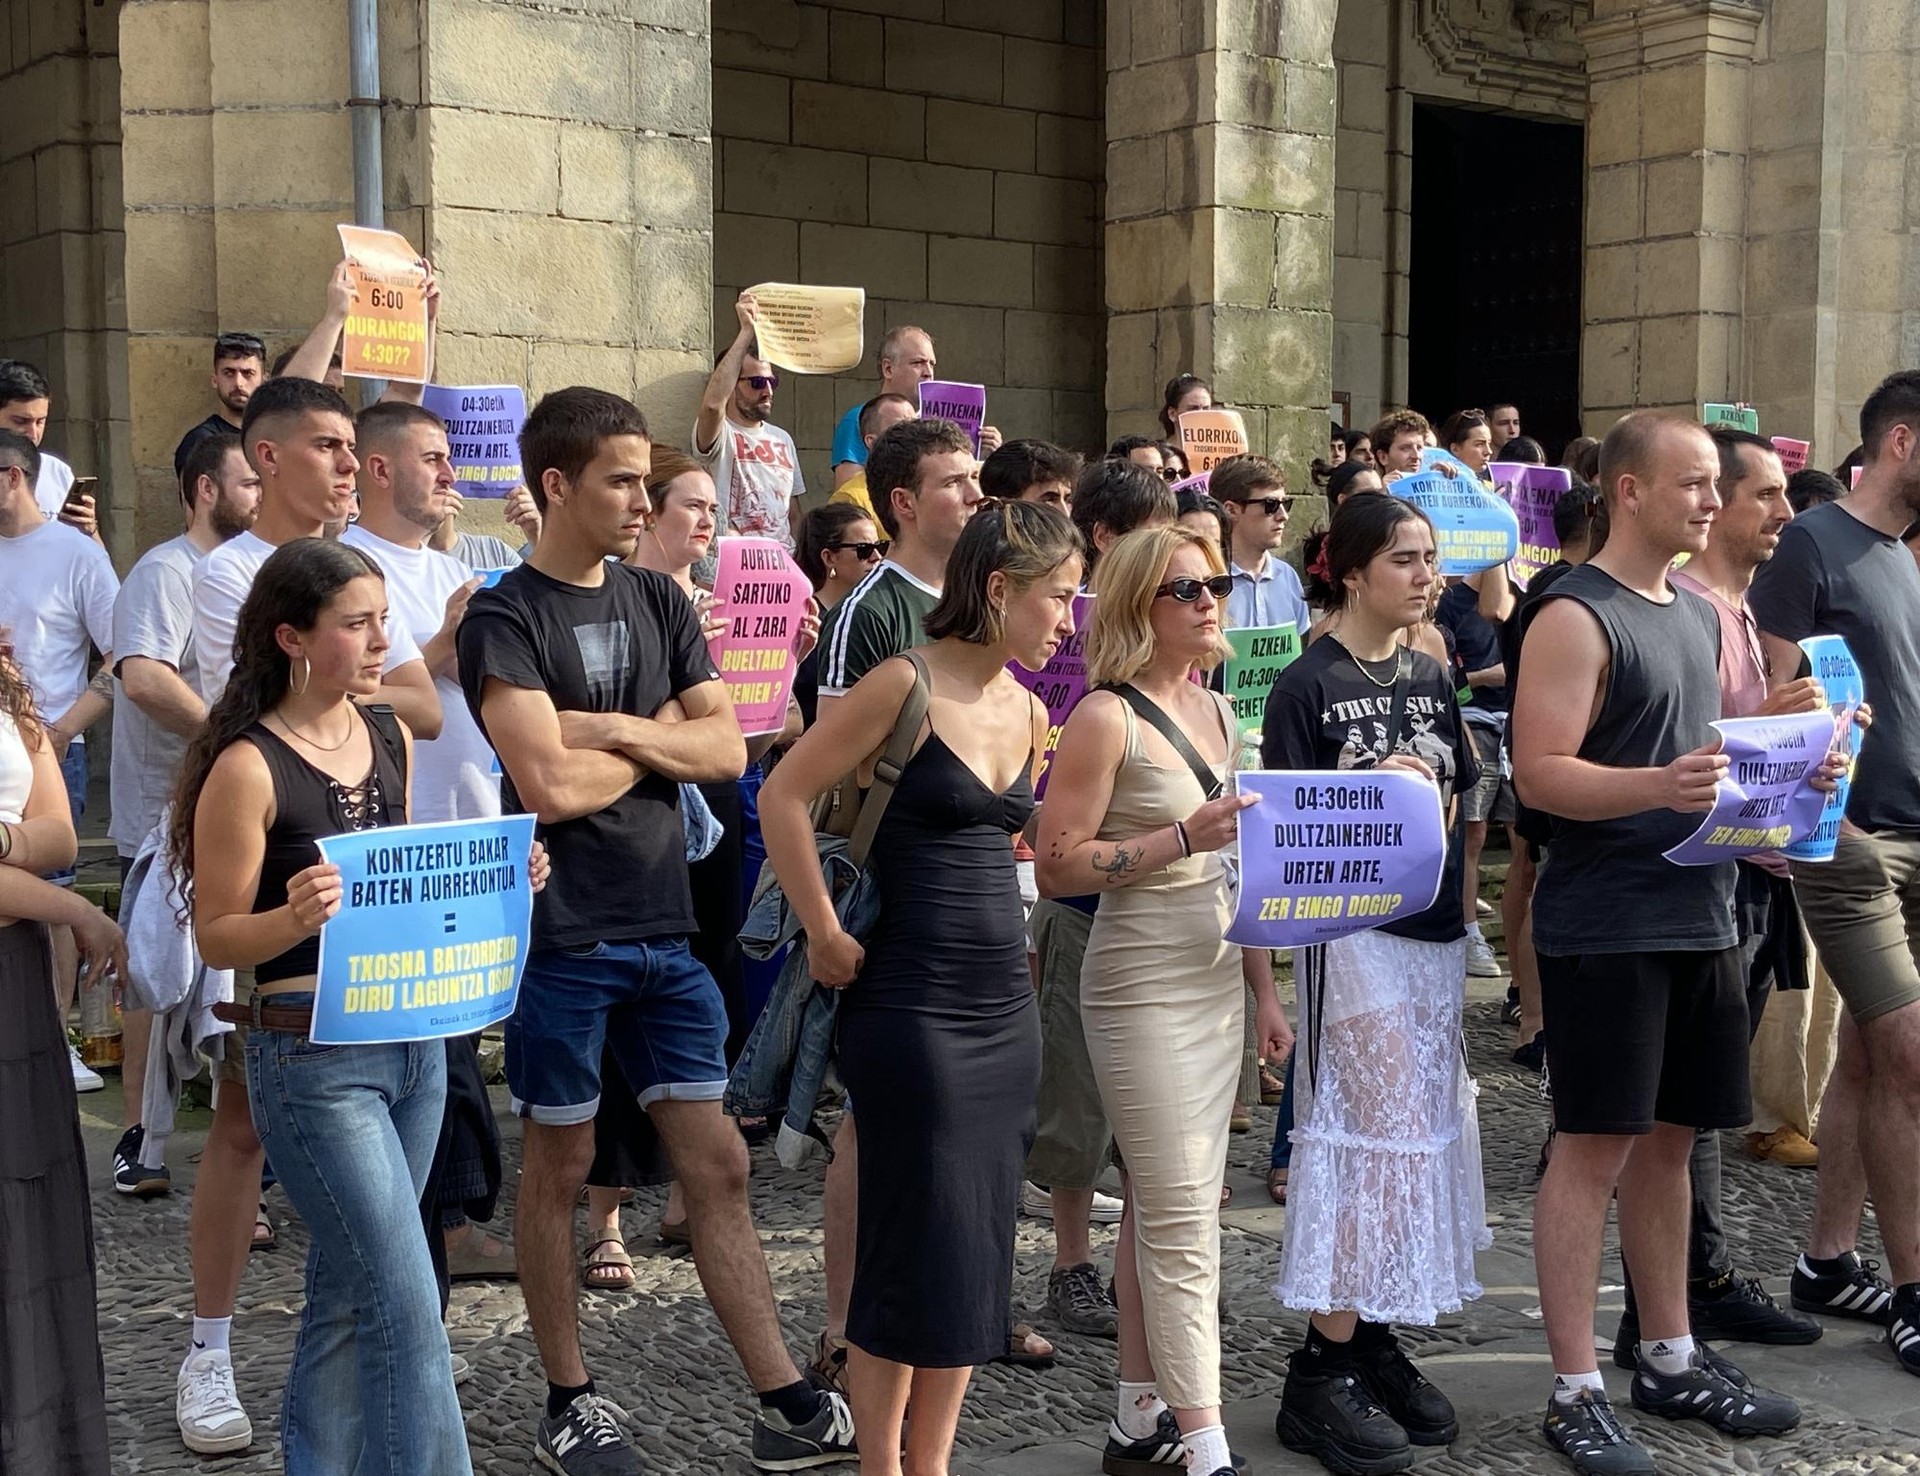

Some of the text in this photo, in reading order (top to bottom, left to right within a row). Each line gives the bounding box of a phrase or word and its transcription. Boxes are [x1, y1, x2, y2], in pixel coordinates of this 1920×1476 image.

[371, 288, 403, 310] 6:00
[345, 315, 425, 342] DURANGON
[362, 342, 410, 366] 4:30??
[461, 395, 505, 412] 04:30etik
[485, 443, 512, 459] ARTE,
[1411, 479, 1464, 494] KONTZERTU
[740, 548, 790, 573] AURTEN,
[732, 582, 791, 605] SARTUKO
[732, 616, 788, 638] AL ZARA
[1250, 634, 1293, 658] AZKENA
[721, 648, 789, 672] BUELTAKO
[1331, 697, 1376, 722] THE
[1294, 785, 1385, 811] 04:30etik
[1274, 822, 1403, 848] DULTZAINERUEK
[365, 835, 509, 876] KONTZERTU BAKAR
[1283, 860, 1384, 885] URTEN ARTE,
[351, 864, 516, 908] BATEN AURREKONTUA
[1258, 893, 1403, 921] ZER EINGO DOGU?
[348, 934, 518, 984] TXOSNA BATZORDEKO
[343, 984, 395, 1015] DIRU
[401, 974, 485, 1010] LAGUNTZA
[487, 964, 516, 996] OSOA
